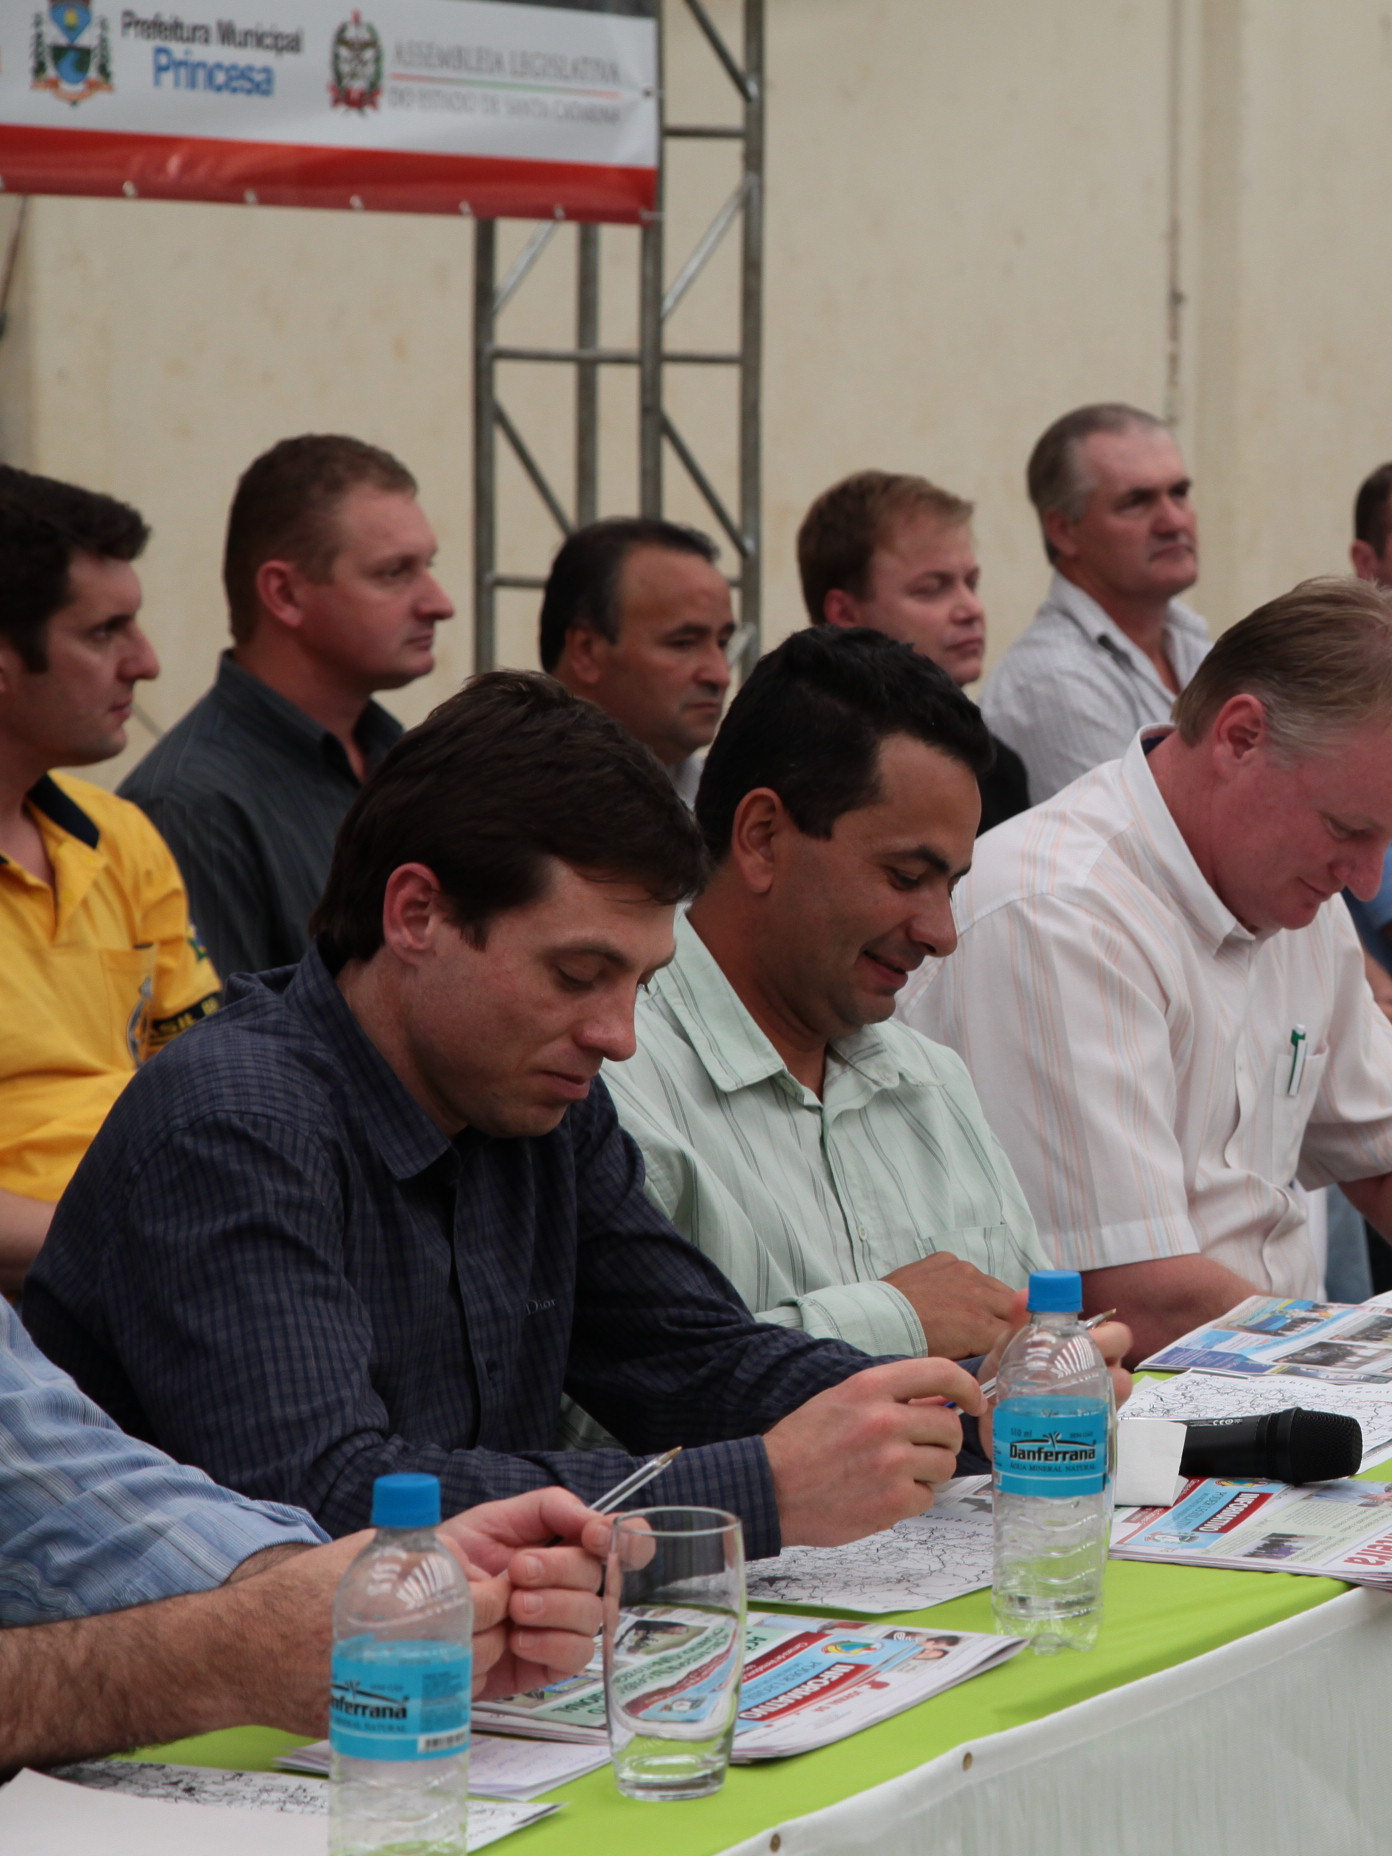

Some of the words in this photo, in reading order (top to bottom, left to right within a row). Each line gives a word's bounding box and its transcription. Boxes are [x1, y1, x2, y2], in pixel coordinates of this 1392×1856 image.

[121, 9, 211, 46] Prefeitura
[215, 18, 304, 57] Municipal
[153, 45, 274, 96] Princesa
[1009, 1442, 1096, 1462] Danferrana
[1029, 1464, 1062, 1473] MINERAL
[1065, 1464, 1096, 1473] NATURAL
[1199, 1492, 1260, 1532] INFORMATIVO
[738, 1664, 856, 1719] INFORMATIVO
